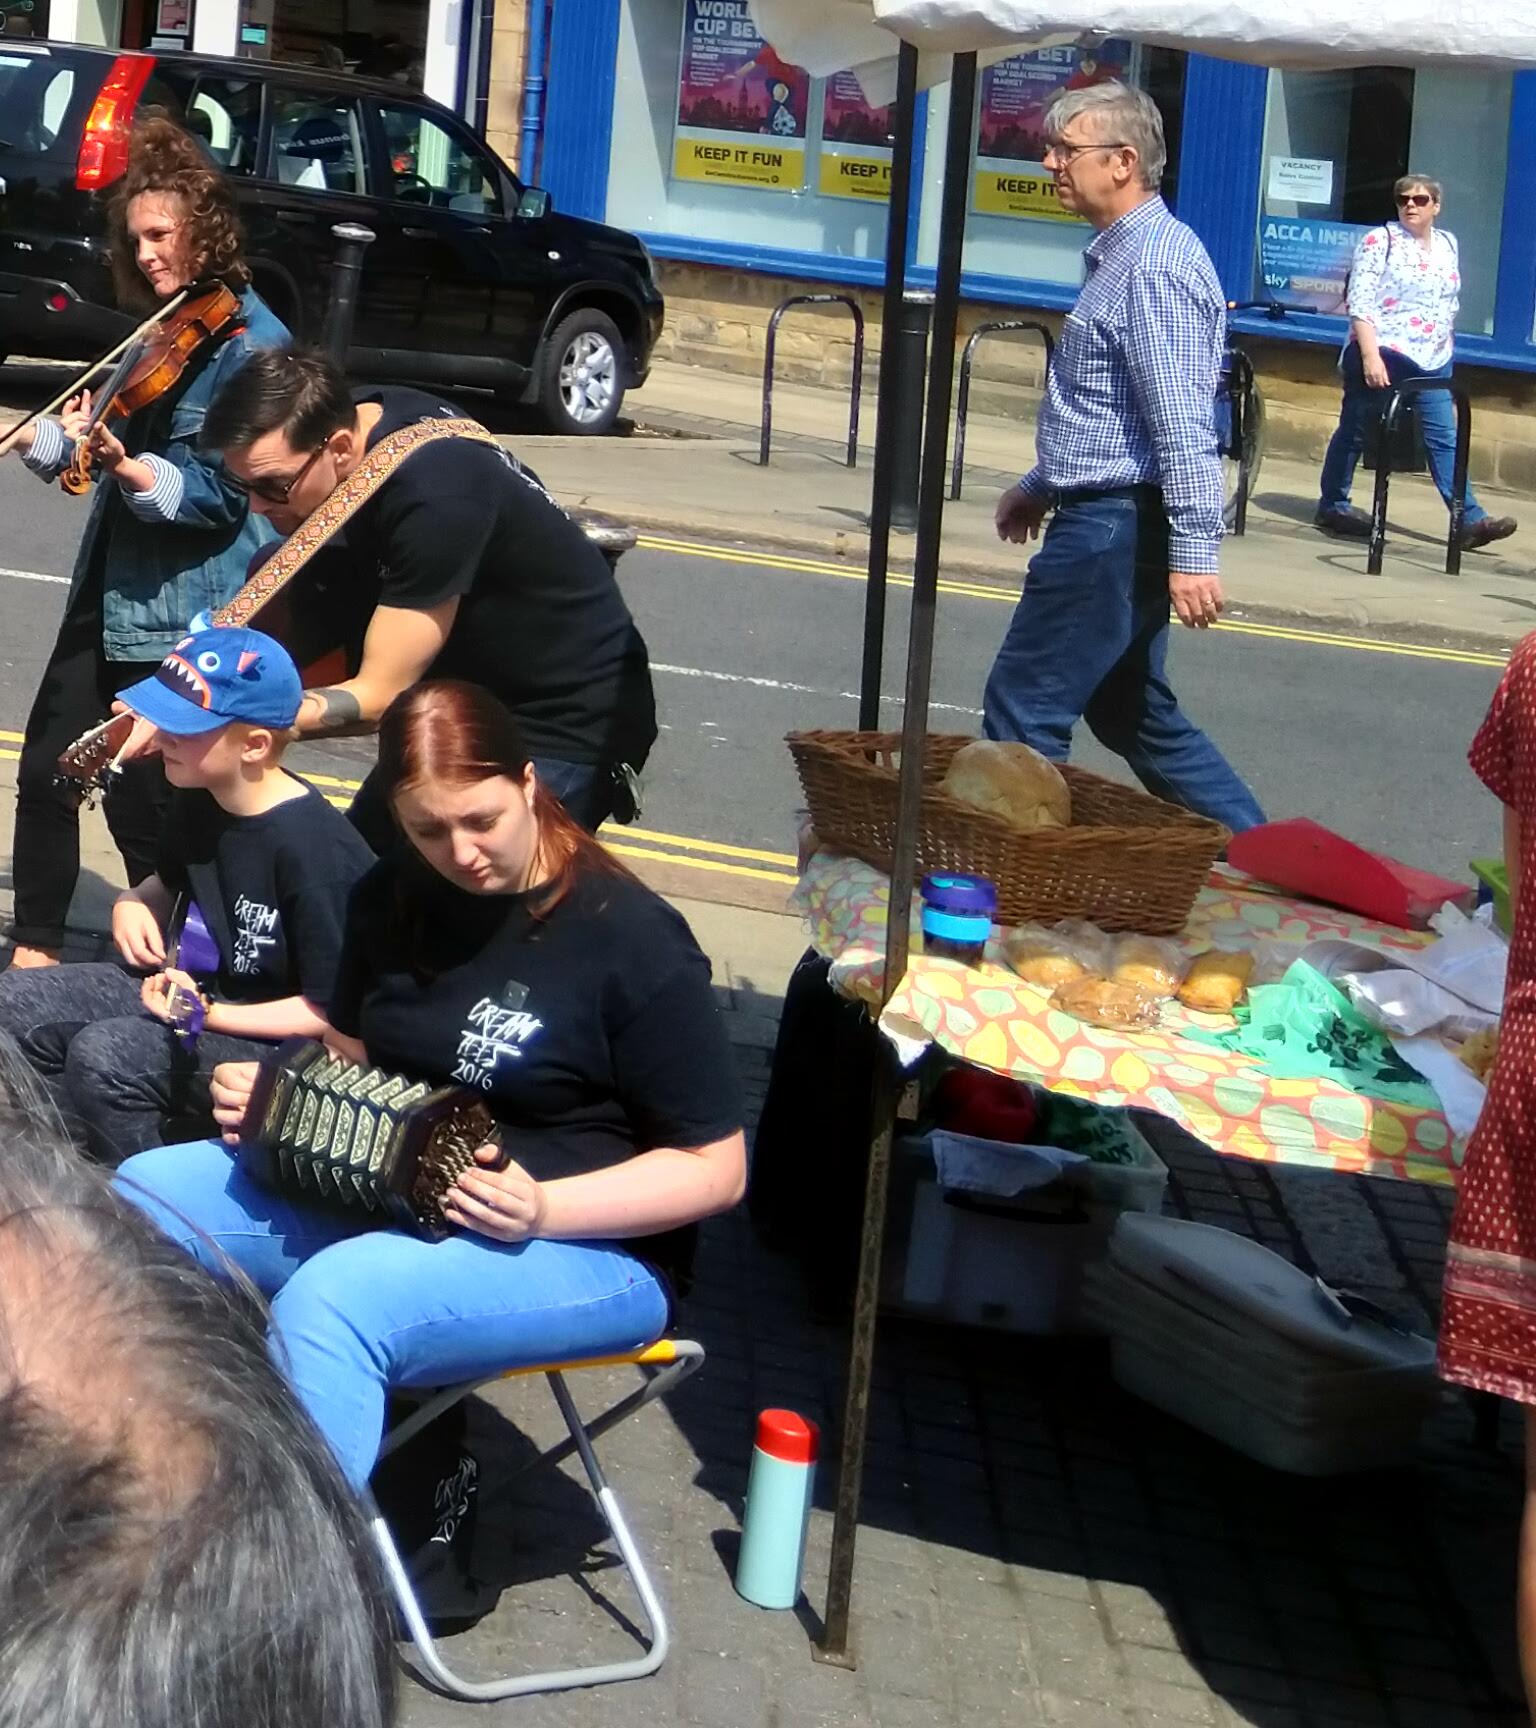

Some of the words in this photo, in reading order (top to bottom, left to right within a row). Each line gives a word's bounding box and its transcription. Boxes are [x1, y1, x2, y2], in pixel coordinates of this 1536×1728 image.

[695, 0, 752, 20] WORL
[694, 18, 727, 35] CUP
[694, 145, 731, 162] KEEP
[735, 149, 748, 163] IT
[752, 153, 783, 167] FUN
[840, 161, 878, 179] KEEP
[1281, 161, 1322, 171] VACANCY
[996, 177, 1037, 194] KEEP
[1042, 181, 1058, 196] IT
[1263, 223, 1314, 243] ACCA
[1264, 273, 1289, 289] sky
[449, 1058, 494, 1090] 2016
